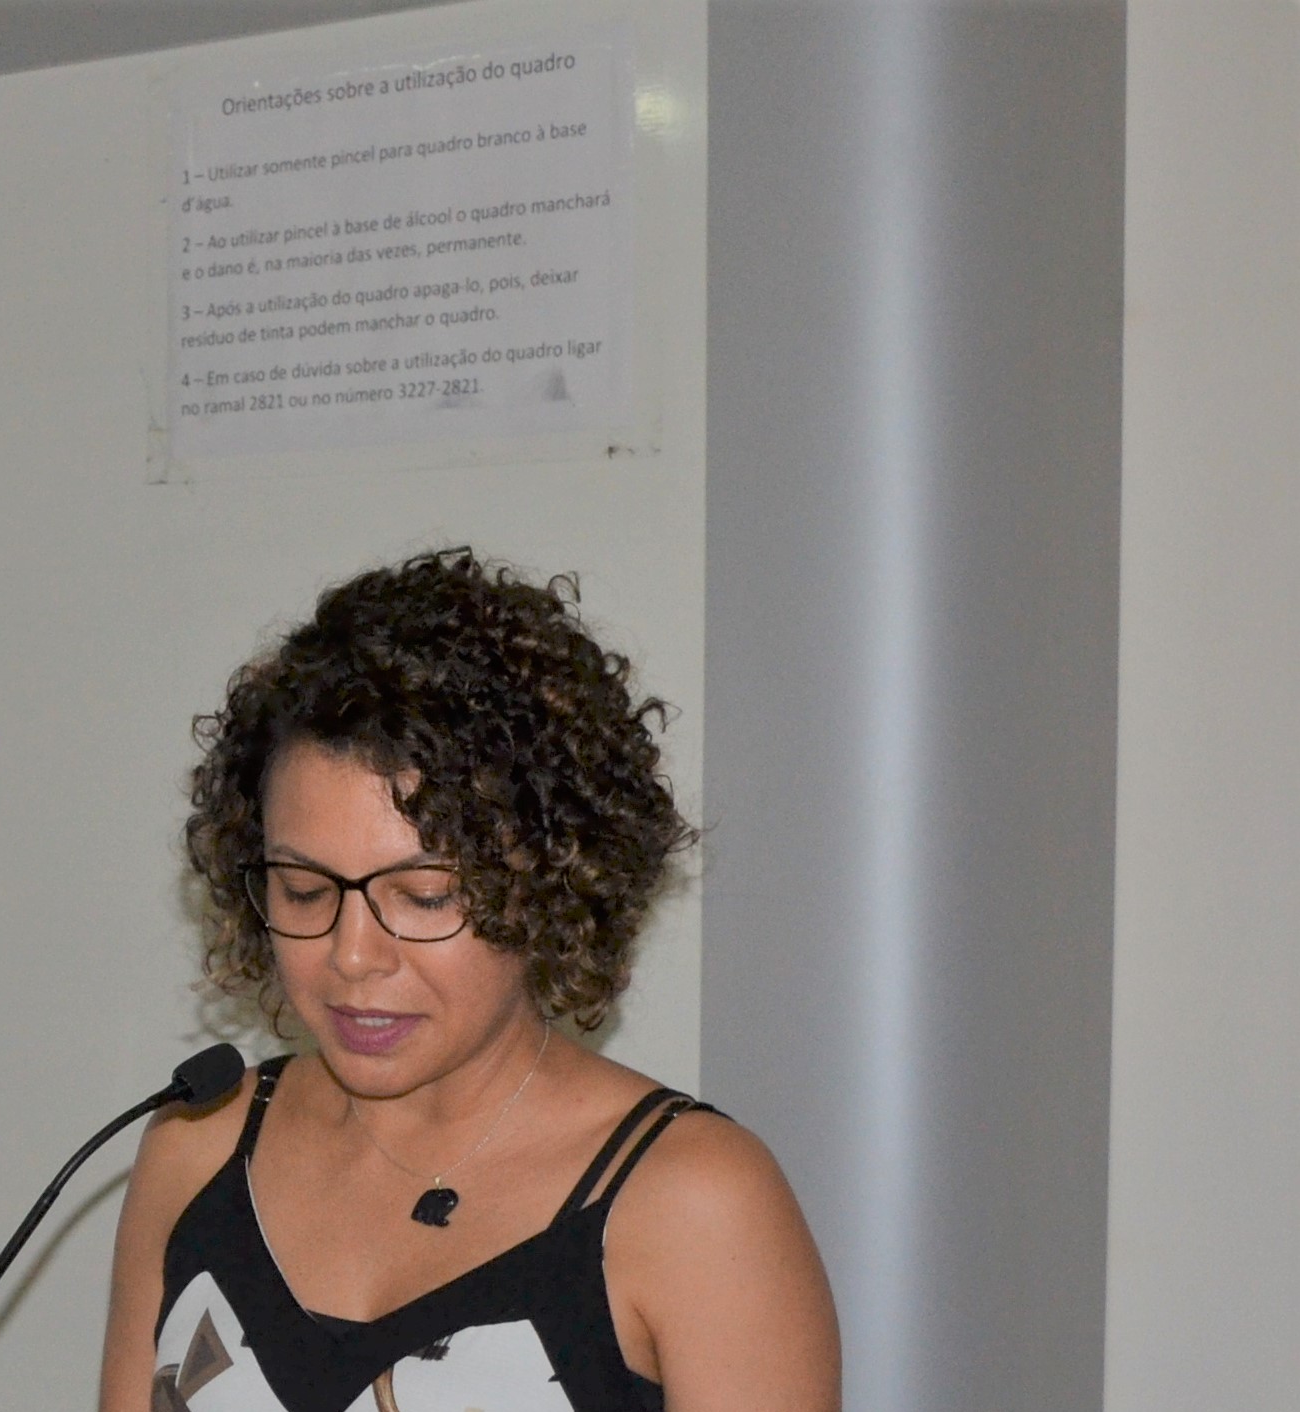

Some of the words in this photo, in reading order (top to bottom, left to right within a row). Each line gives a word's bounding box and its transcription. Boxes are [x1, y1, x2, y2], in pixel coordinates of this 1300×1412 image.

[221, 88, 322, 116] Orientações
[326, 81, 375, 101] sobre
[379, 80, 389, 94] a
[394, 65, 477, 93] utilização
[482, 61, 505, 80] do
[510, 53, 576, 80] quadro
[182, 169, 190, 186] 1
[208, 161, 259, 182] Utilizar
[263, 154, 327, 176] somente
[331, 145, 376, 169] pincel
[379, 145, 413, 165] para
[416, 135, 474, 159] quadro
[477, 130, 531, 149] branco
[535, 123, 546, 141] à
[550, 121, 588, 140] base
[182, 237, 190, 253] 2
[207, 234, 227, 249] Ao
[231, 228, 281, 249] utilizar
[284, 222, 329, 245] pincel
[344, 217, 380, 236] base
[383, 213, 403, 231] de
[405, 207, 453, 229] álcool
[455, 208, 467, 223] o
[470, 201, 527, 223] quadro
[530, 189, 612, 215] manchará
[181, 268, 191, 281] e
[194, 265, 205, 280] o
[207, 261, 244, 279] dano
[265, 257, 283, 273] na
[286, 250, 344, 270] maioria
[346, 245, 373, 265] das
[425, 232, 528, 258] permanente.
[182, 304, 191, 321] 3
[206, 302, 243, 320] Após
[245, 301, 256, 315] a
[258, 291, 328, 314] utilização
[331, 289, 352, 307] do
[355, 285, 409, 307] quadro
[529, 268, 580, 288] deixar
[180, 328, 235, 349] resíduo
[238, 327, 257, 344] de
[260, 325, 295, 342] tinta
[298, 320, 352, 342] podem
[354, 312, 422, 333] manchar
[424, 312, 436, 327] o
[181, 372, 190, 388] 4
[206, 369, 230, 388] Em
[233, 368, 266, 385] caso
[269, 364, 288, 382] de
[291, 360, 342, 381] dúvida
[345, 357, 388, 376] sobre
[390, 357, 400, 371] a
[403, 349, 478, 370] utilização
[481, 347, 502, 364] do
[505, 342, 564, 364] quadro
[567, 338, 603, 360] ligar
[180, 401, 200, 417] no
[203, 396, 246, 415] ramal
[248, 393, 284, 412] 2821
[288, 394, 309, 409] ou
[311, 392, 332, 407] no
[334, 385, 394, 405] número
